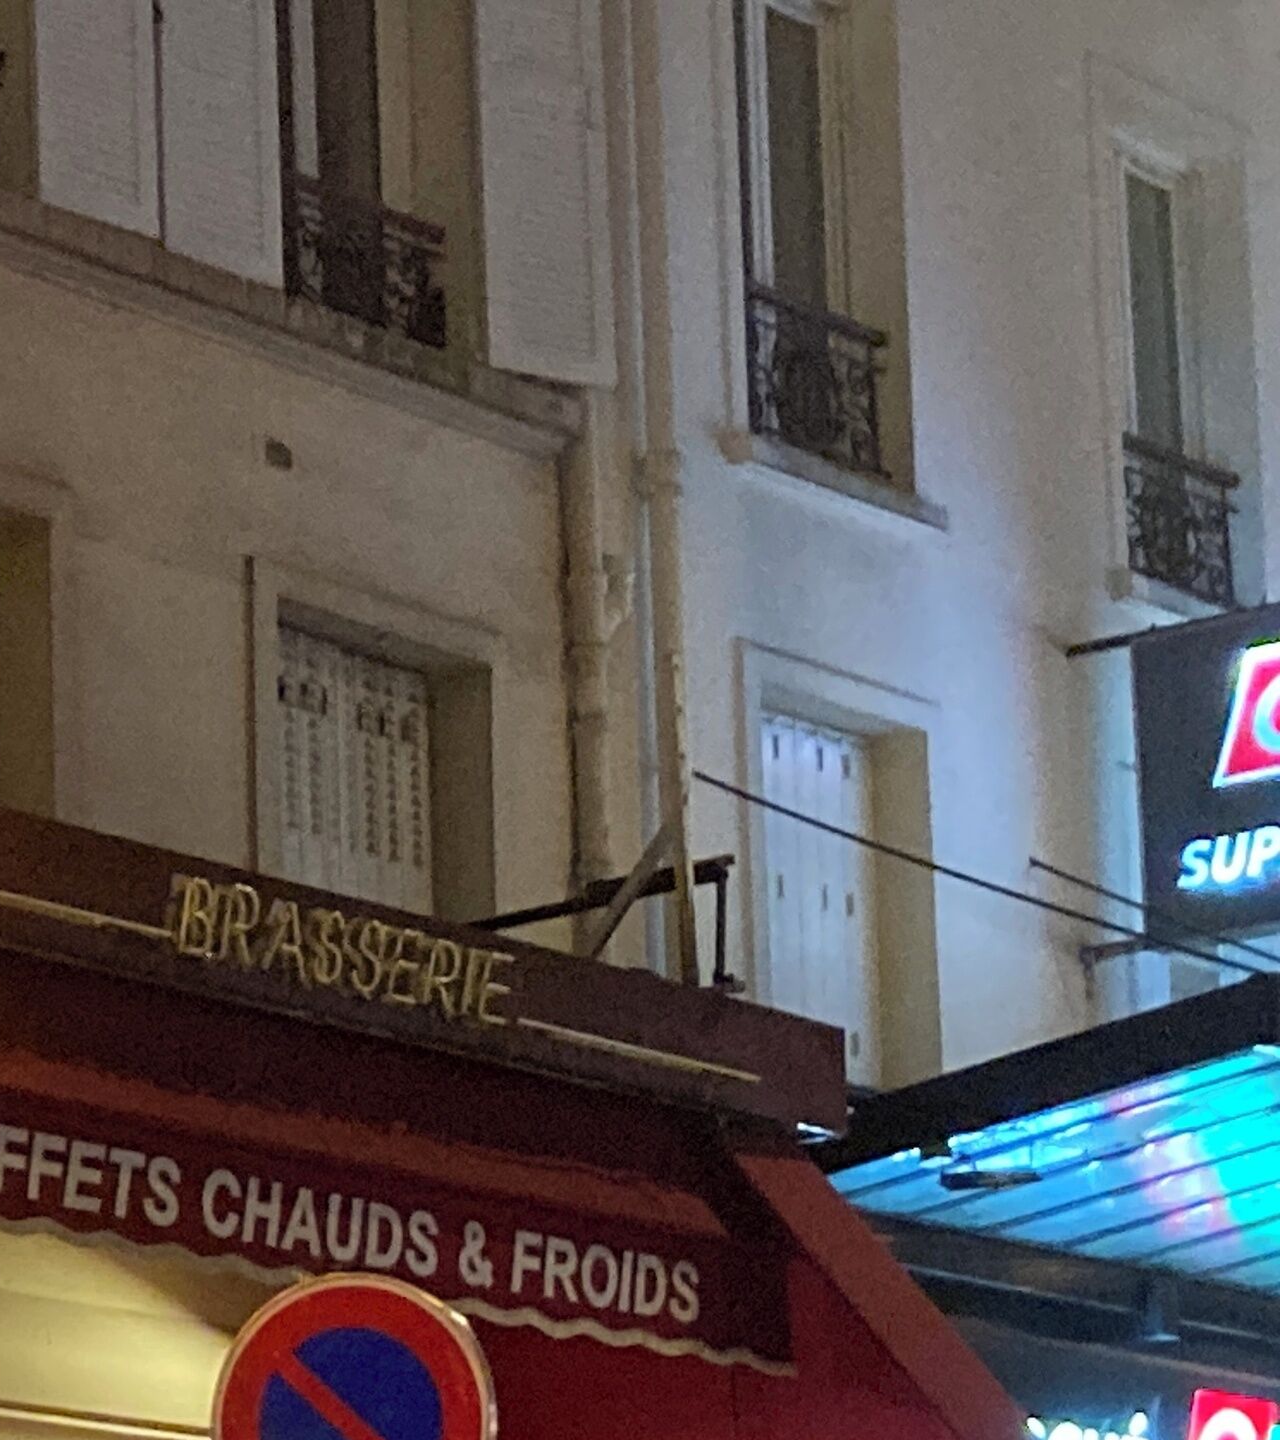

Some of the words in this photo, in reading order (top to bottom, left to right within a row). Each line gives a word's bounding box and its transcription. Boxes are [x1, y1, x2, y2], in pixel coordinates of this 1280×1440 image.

[171, 872, 516, 1025] BRASSERIE
[202, 1168, 439, 1278] CHAUDS
[458, 1220, 494, 1289] &
[511, 1229, 700, 1325] FROIDS
